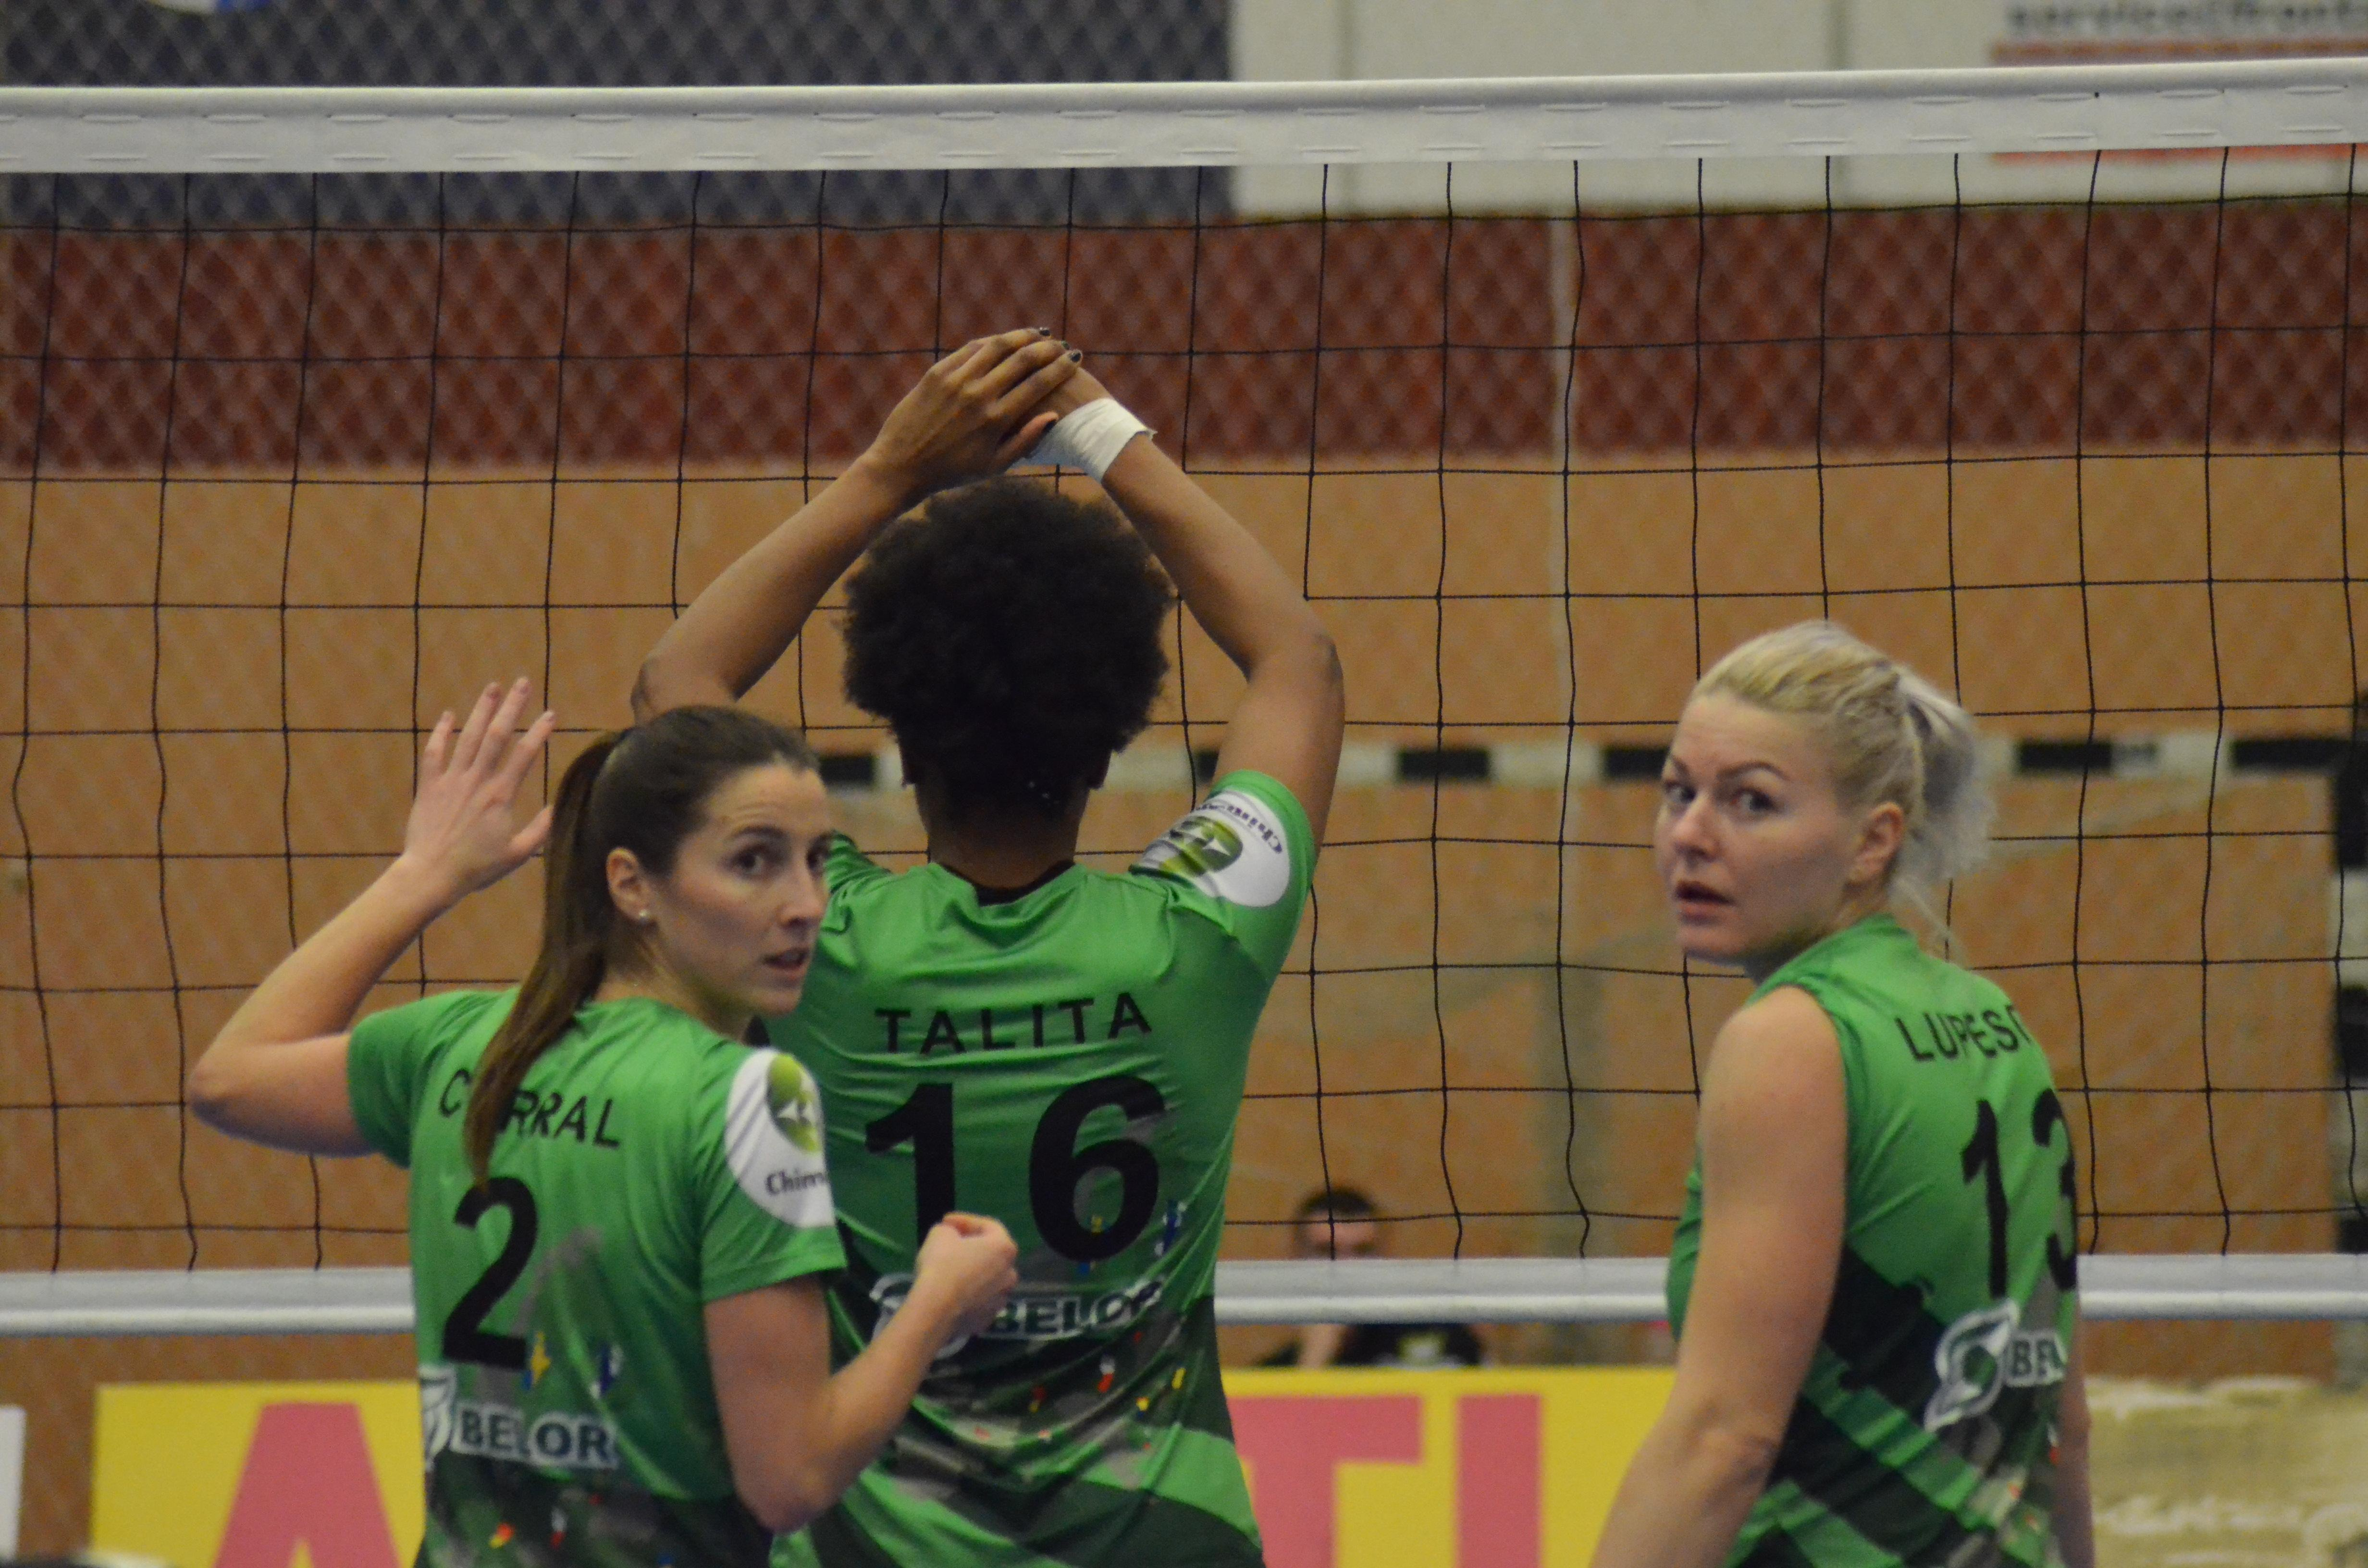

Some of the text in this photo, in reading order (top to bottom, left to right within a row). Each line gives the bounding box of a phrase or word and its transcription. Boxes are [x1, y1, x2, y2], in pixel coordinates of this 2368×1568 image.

[439, 1067, 621, 1150] CRRAL
[875, 992, 1152, 1055] TALITA
[866, 1076, 1167, 1263] 16
[1961, 1088, 2077, 1299] 13
[443, 1176, 538, 1371] 2
